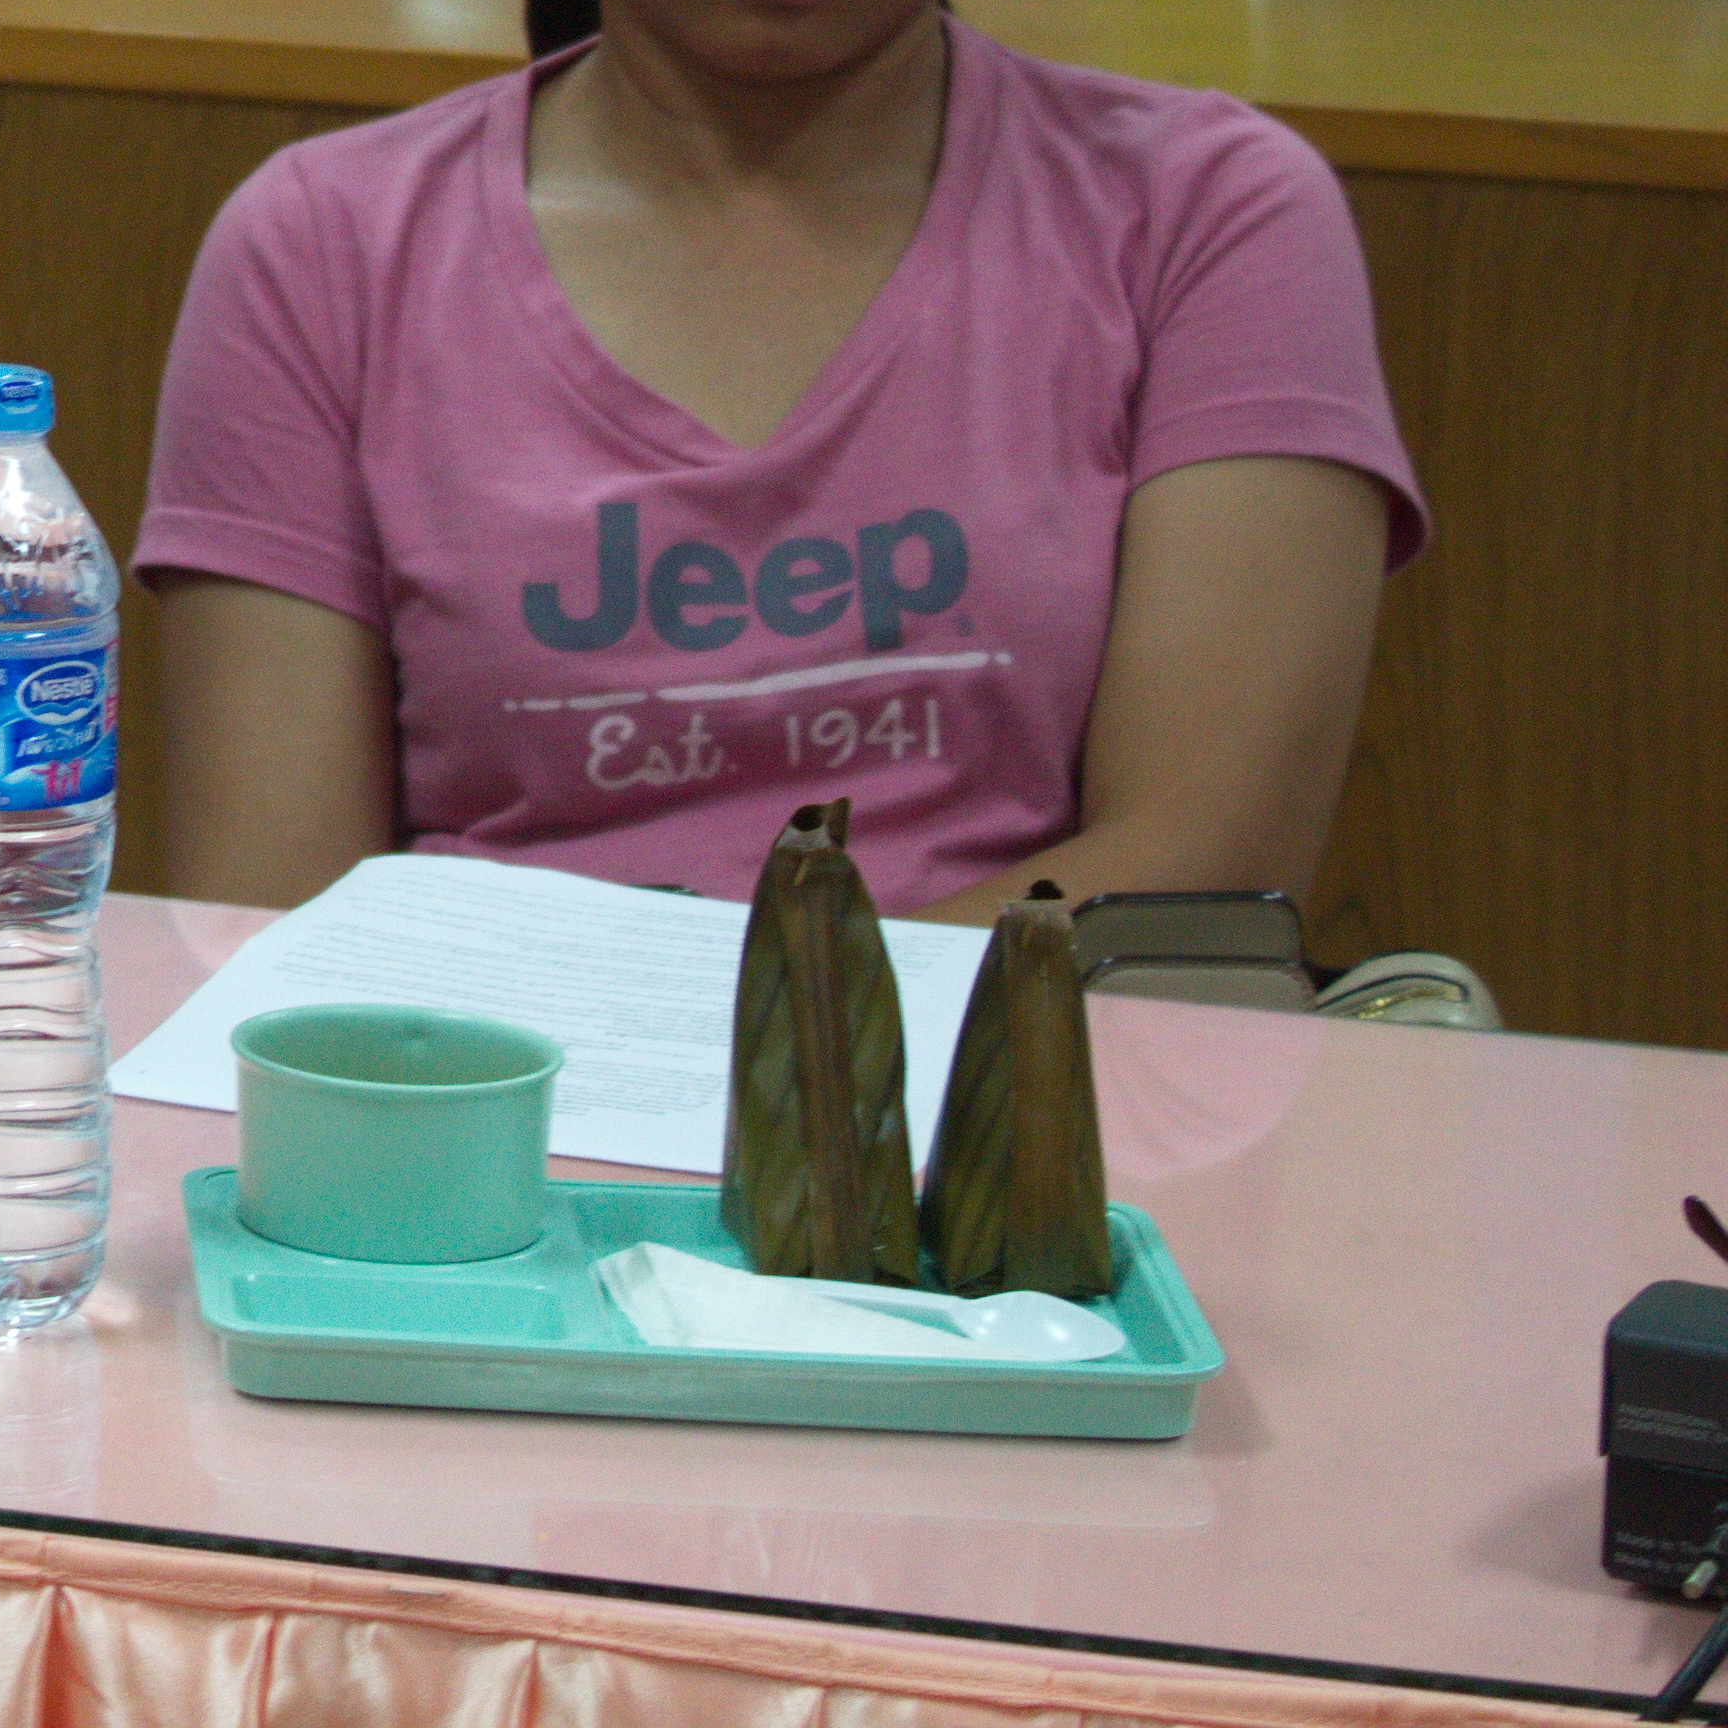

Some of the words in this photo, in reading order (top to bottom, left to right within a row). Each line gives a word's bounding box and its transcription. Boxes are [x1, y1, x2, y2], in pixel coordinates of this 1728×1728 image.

[520, 502, 970, 653] Jeep
[585, 713, 744, 791] Est.
[784, 697, 943, 770] 1941
